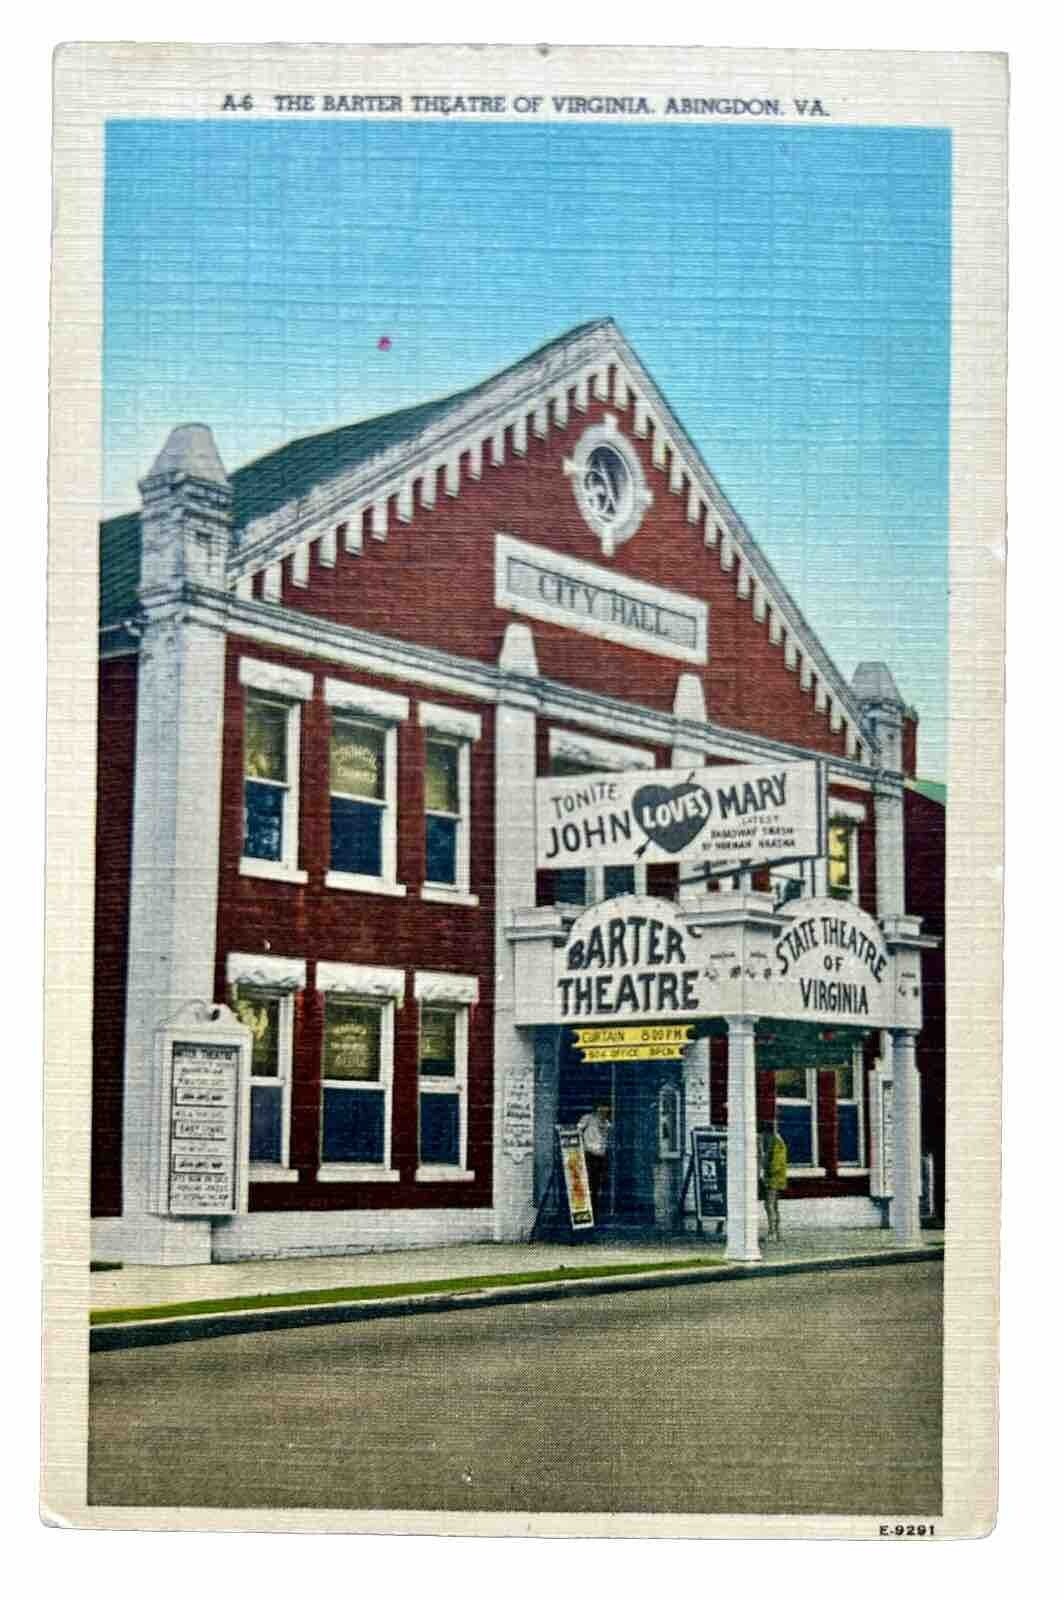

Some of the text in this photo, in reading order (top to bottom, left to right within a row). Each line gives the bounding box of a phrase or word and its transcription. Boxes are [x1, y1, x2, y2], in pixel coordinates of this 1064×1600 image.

[273, 95, 315, 112] THE
[322, 95, 402, 112] BARTER
[411, 96, 506, 114] THEATRE
[513, 96, 543, 113] OF
[537, 573, 668, 635] CITY HALL
[546, 772, 787, 859] JOHN LOVES MARY
[567, 916, 687, 970] BARTER
[775, 916, 888, 984] STATE THEATRE
[823, 955, 844, 972] OF
[558, 970, 700, 1017] THEATRE
[799, 977, 869, 1016] VIRGINIA
[879, 1524, 935, 1536] E-9291
